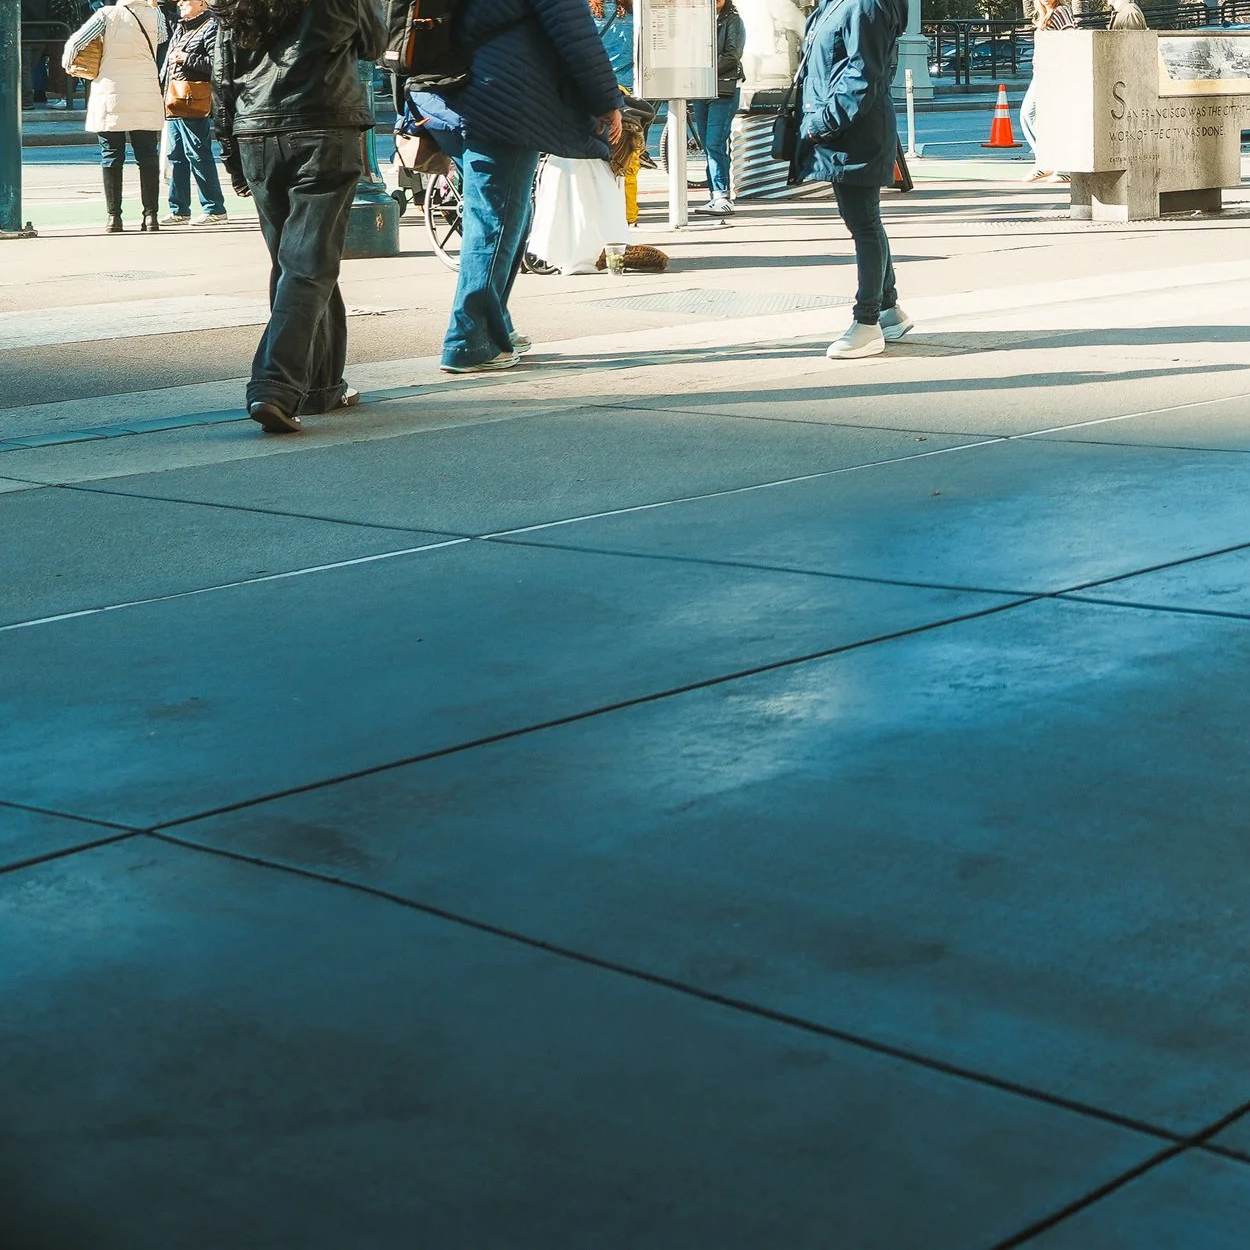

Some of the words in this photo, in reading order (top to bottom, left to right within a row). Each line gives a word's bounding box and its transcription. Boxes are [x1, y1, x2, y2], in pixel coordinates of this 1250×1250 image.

[1141, 107, 1187, 118] FRANCISCO
[1188, 106, 1206, 117] WAS
[1208, 105, 1222, 116] THE
[1109, 130, 1135, 142] WORK
[1137, 129, 1147, 140] OF
[1150, 129, 1163, 139] THE
[1182, 127, 1200, 138] WAS
